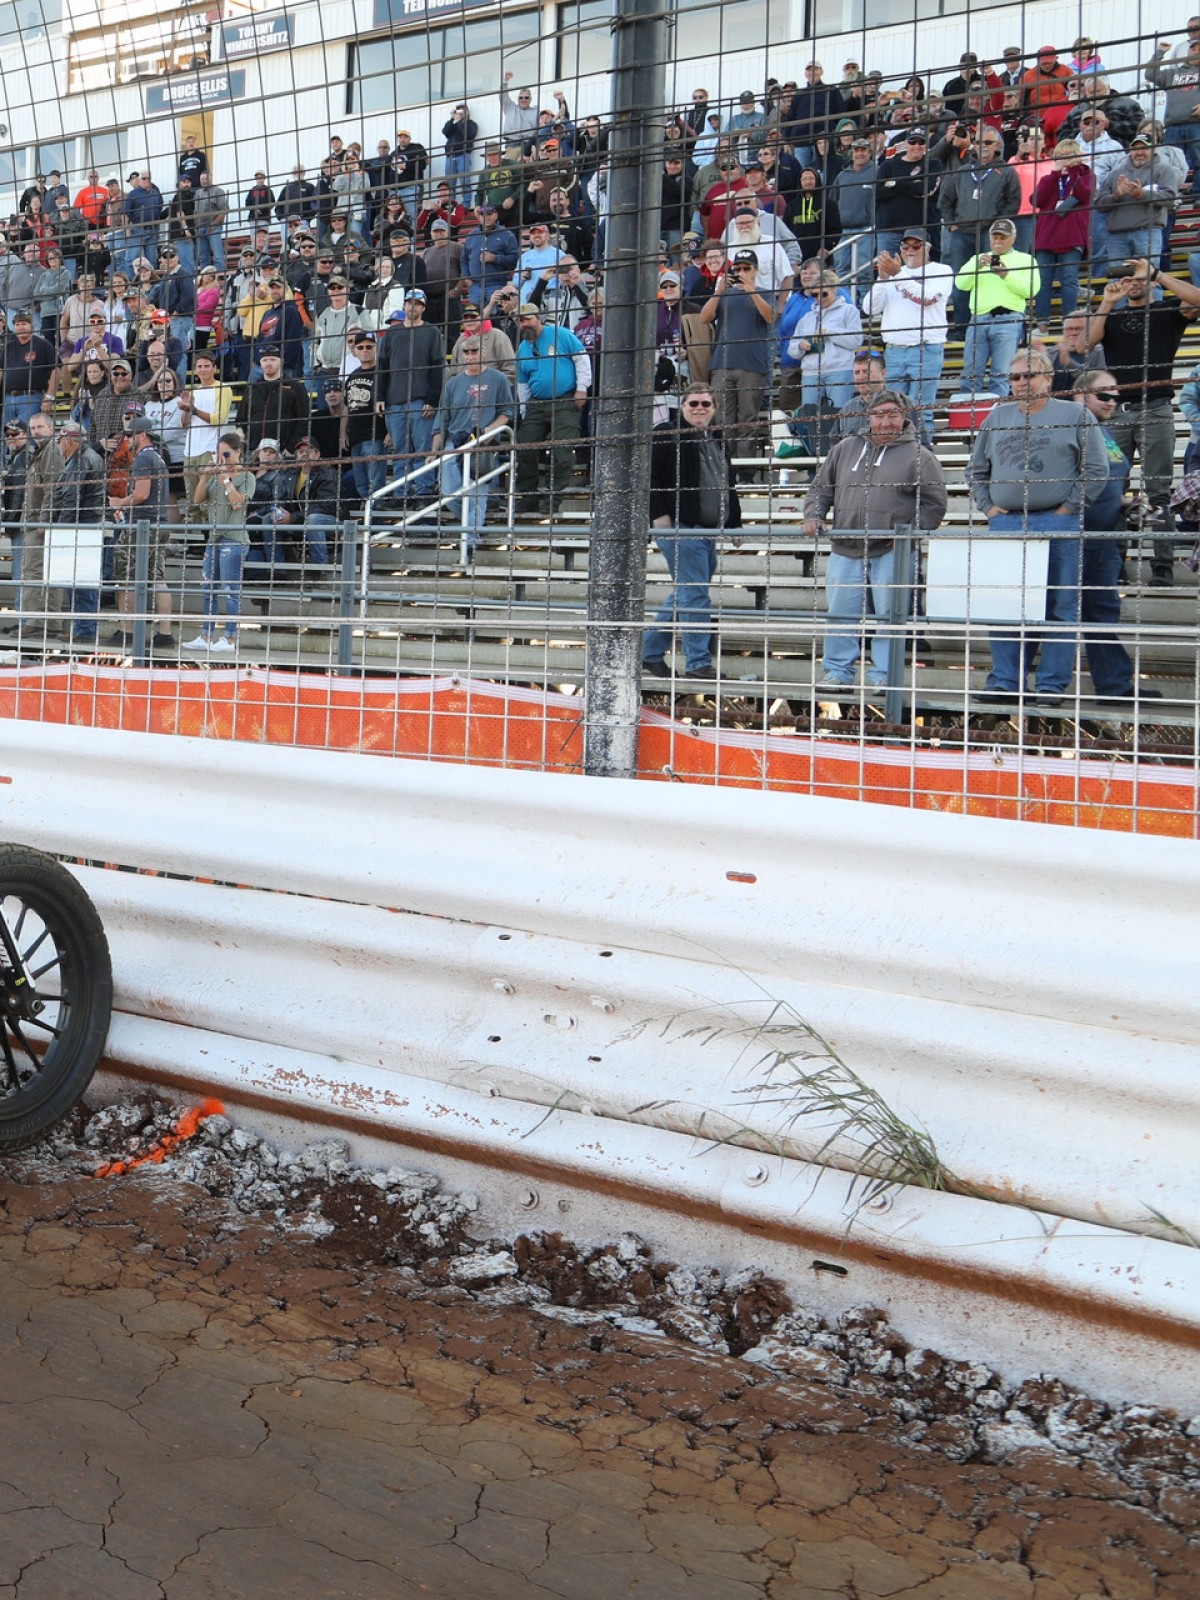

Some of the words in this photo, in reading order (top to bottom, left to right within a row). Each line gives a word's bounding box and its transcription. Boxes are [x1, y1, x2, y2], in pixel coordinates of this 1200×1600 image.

[428, 0, 461, 9] HO
[238, 21, 275, 39] TOMMY
[163, 83, 198, 101] BRUCE
[200, 78, 227, 94] ELLIS
